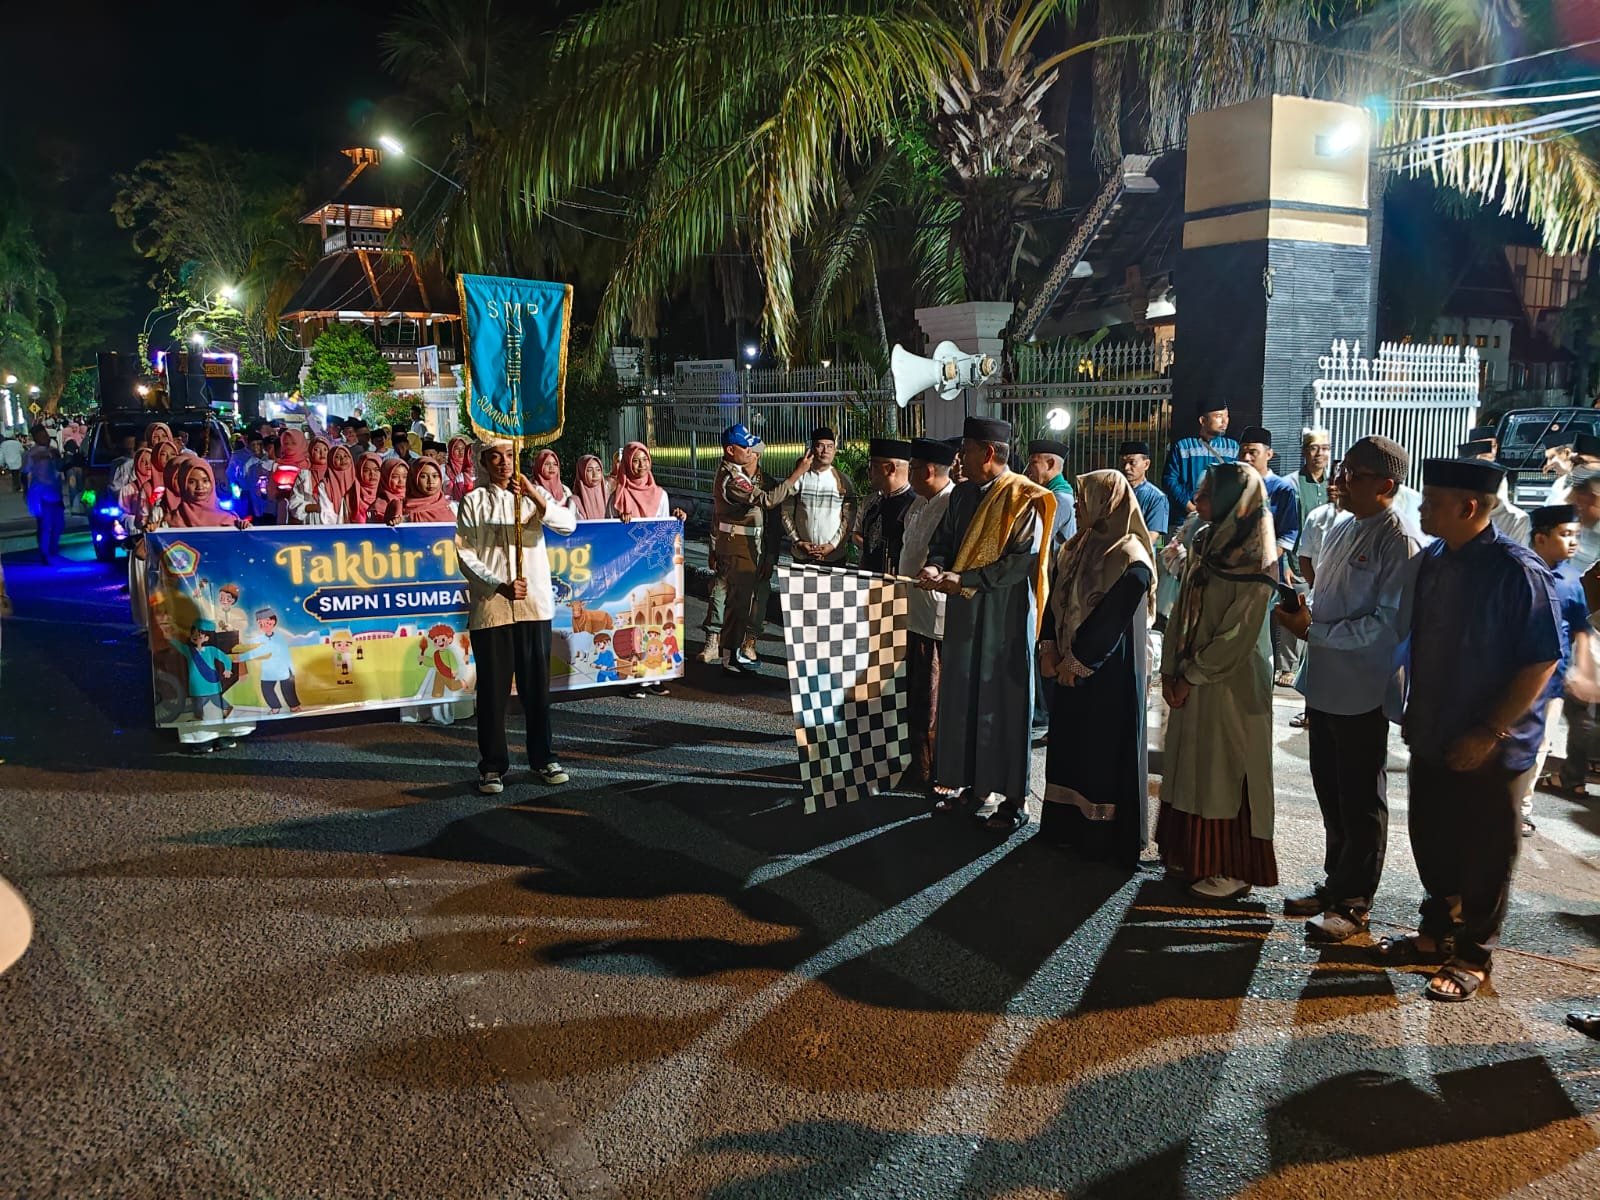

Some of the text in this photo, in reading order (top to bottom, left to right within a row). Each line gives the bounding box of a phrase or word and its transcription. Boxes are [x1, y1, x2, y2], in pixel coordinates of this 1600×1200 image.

[487, 300, 539, 319] SMP
[275, 541, 424, 588] Takbir
[319, 589, 471, 612] SMPN 1 SUMBA
